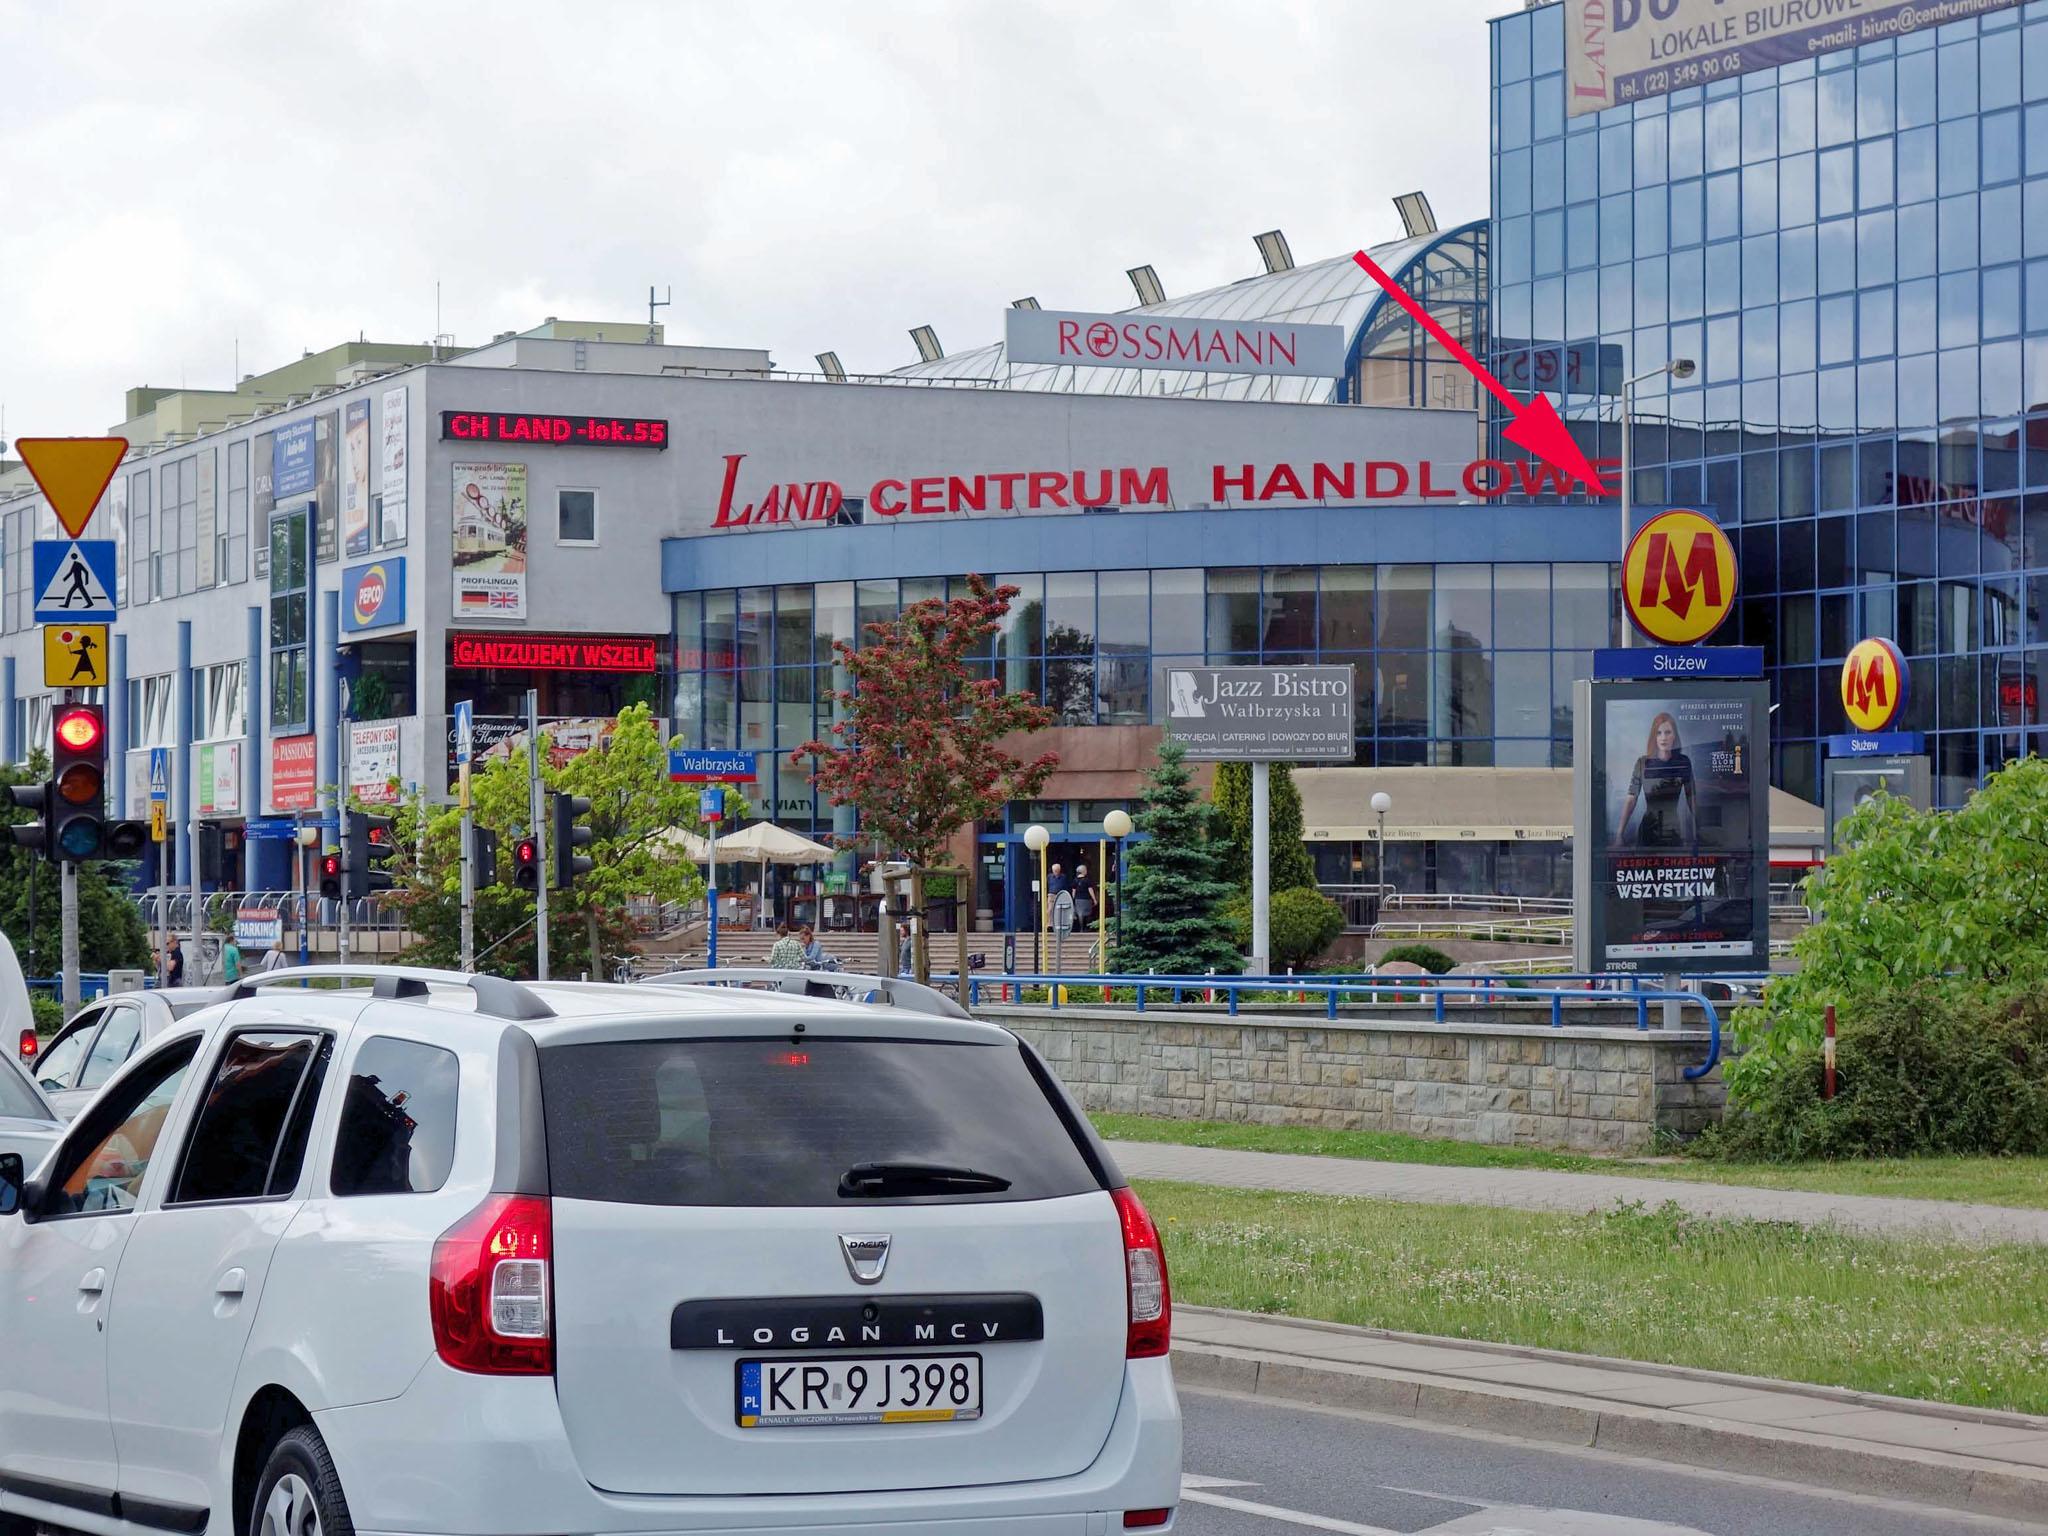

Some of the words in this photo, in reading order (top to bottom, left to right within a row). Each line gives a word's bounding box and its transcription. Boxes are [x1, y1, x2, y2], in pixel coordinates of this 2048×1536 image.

[1650, 16, 1738, 60] LOKALE
[1807, 26, 1857, 51] e-mail:
[1620, 81, 1640, 98] tel.
[1644, 71, 1669, 95] (22)
[1674, 63, 1698, 86] 549
[1702, 57, 1719, 76] 90
[1722, 52, 1741, 71] 05
[1058, 320, 1296, 367] ROSSMANN
[451, 415, 489, 439] CH
[499, 416, 571, 442] LAND
[710, 453, 842, 528] LAND
[869, 467, 1169, 516] CENTRUM
[1213, 458, 1622, 501] HANDLOWE
[461, 577, 519, 586] PROFI-LINGUA
[359, 585, 381, 605] PEPCO
[458, 641, 581, 666] GANIZUJEMY
[1653, 654, 1708, 672] Służew
[1204, 672, 1263, 705] Jazz
[1271, 672, 1348, 698] Bistro
[1220, 703, 1321, 721] Wałbrzyska
[353, 729, 383, 745] TELEFONY
[472, 723, 523, 737] estauracja
[1222, 732, 1266, 742] CATERING
[1272, 732, 1311, 741] DOWOZY
[1312, 732, 1326, 741] DO
[1327, 732, 1349, 741] BIUR
[280, 741, 314, 761] PASSIONE
[1851, 739, 1879, 752] Służew
[683, 757, 746, 774] Wałbrzyska
[1616, 869, 1654, 882] SAMA
[1657, 867, 1716, 881] PRZECIW
[1616, 882, 1715, 899] WSZYSTKIM
[240, 921, 274, 937] PARKING
[850, 1240, 887, 1249] DACIA
[717, 1325, 881, 1345] LOGAN
[915, 1321, 999, 1341] MCV
[768, 1365, 830, 1412] KR
[845, 1362, 971, 1410] 9J398
[743, 1395, 760, 1409] PL
[758, 1416, 791, 1425] RENAULT
[793, 1414, 834, 1424] WIECZOREK
